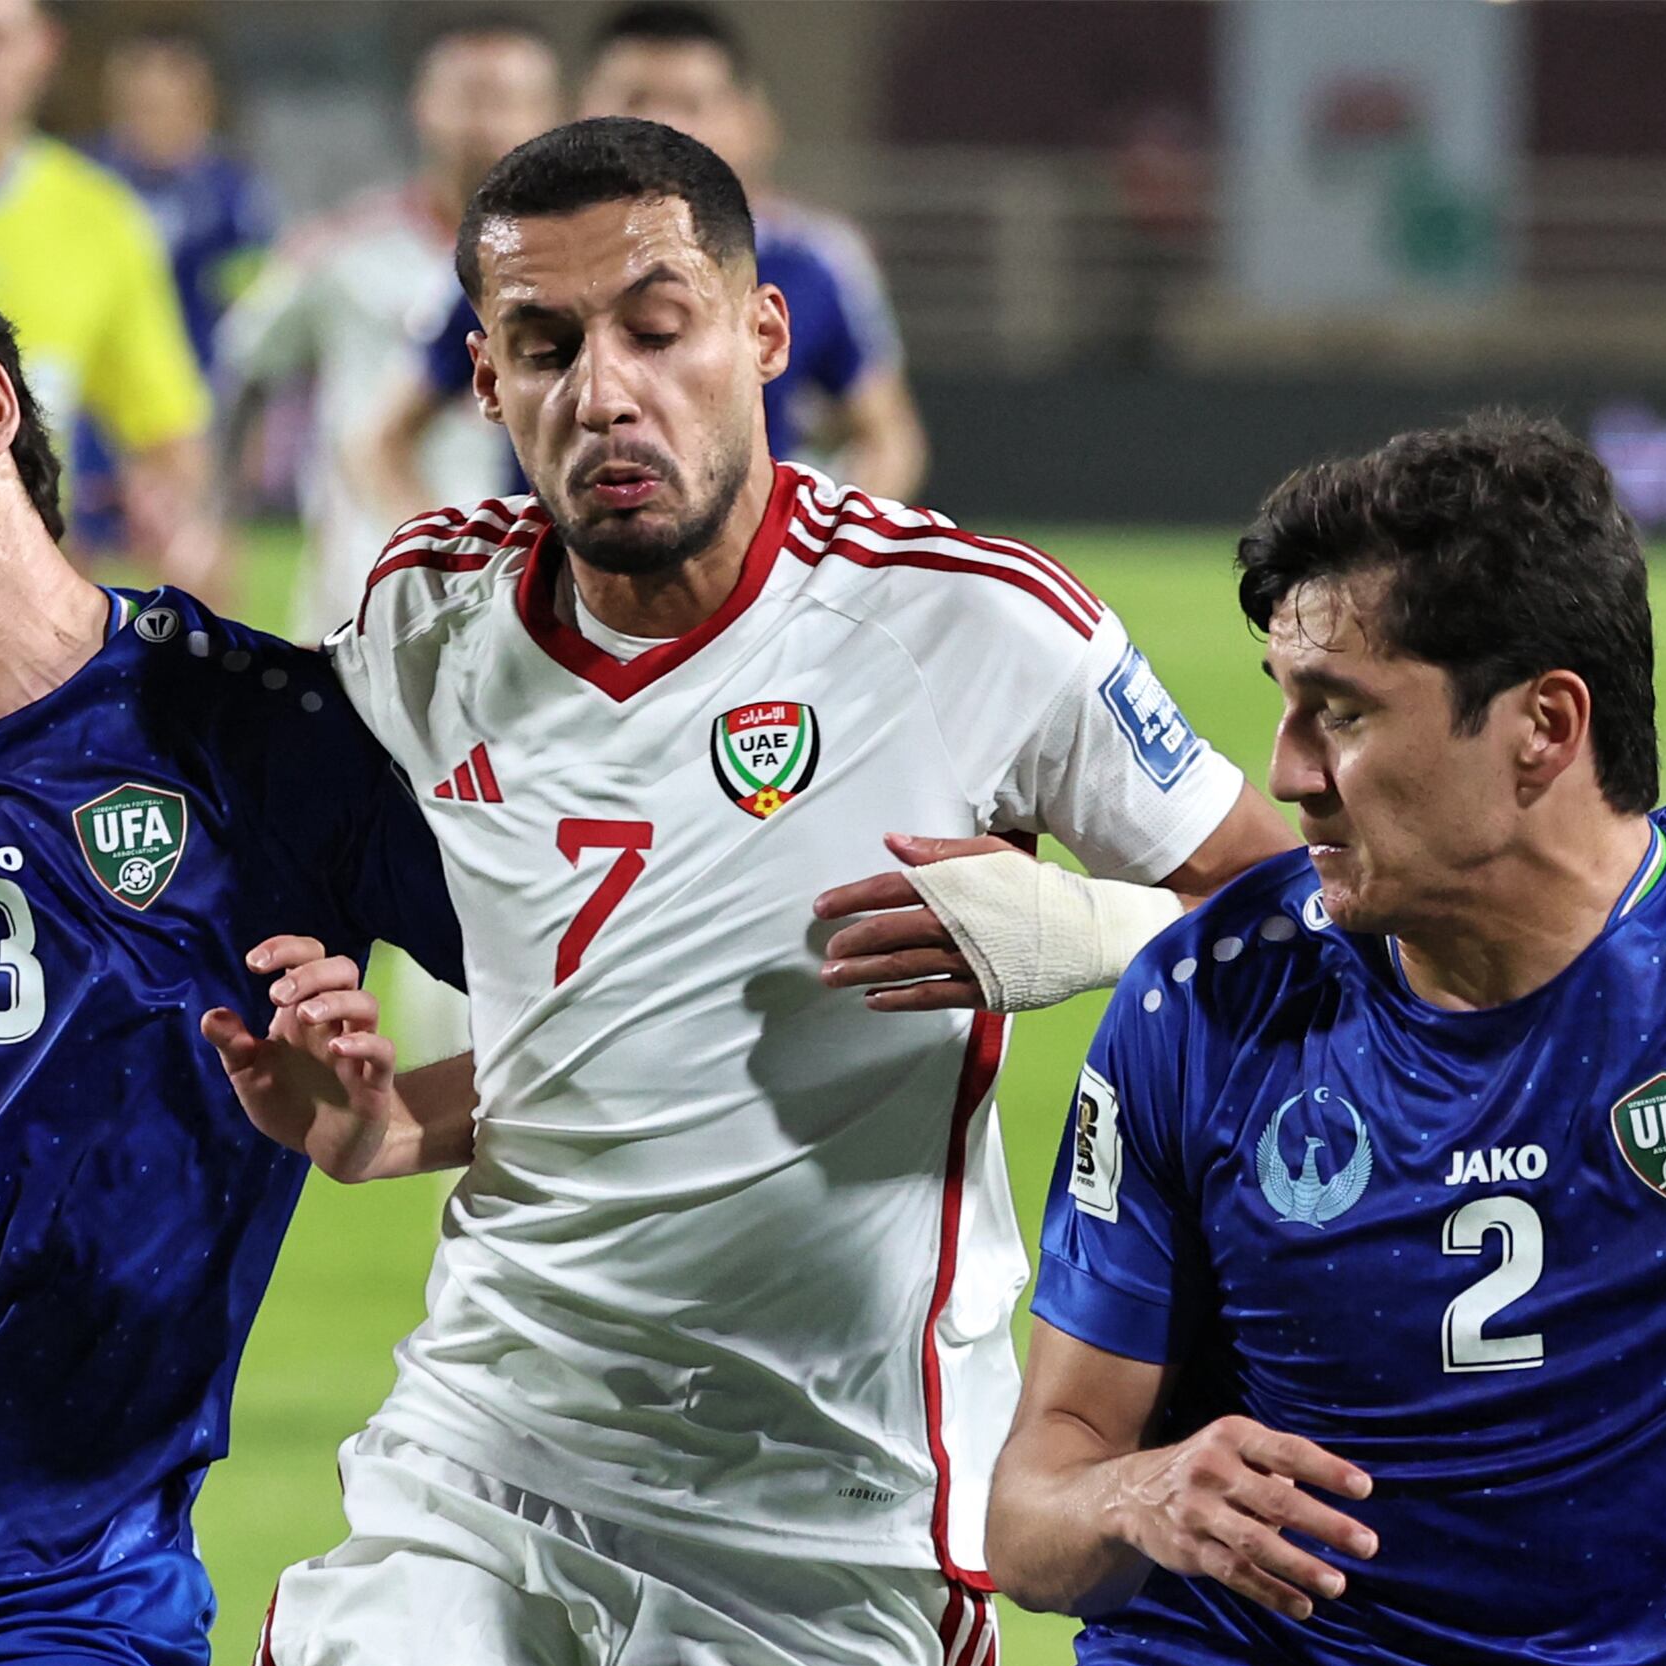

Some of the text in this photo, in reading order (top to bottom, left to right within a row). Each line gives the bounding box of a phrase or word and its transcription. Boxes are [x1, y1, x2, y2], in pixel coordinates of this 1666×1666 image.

[740, 732, 789, 752] UAE
[752, 752, 779, 768] FA
[93, 805, 173, 853] UFA
[554, 818, 654, 989] 7
[1445, 1144, 1548, 1186] JAKO
[1441, 1195, 1545, 1374] 2
